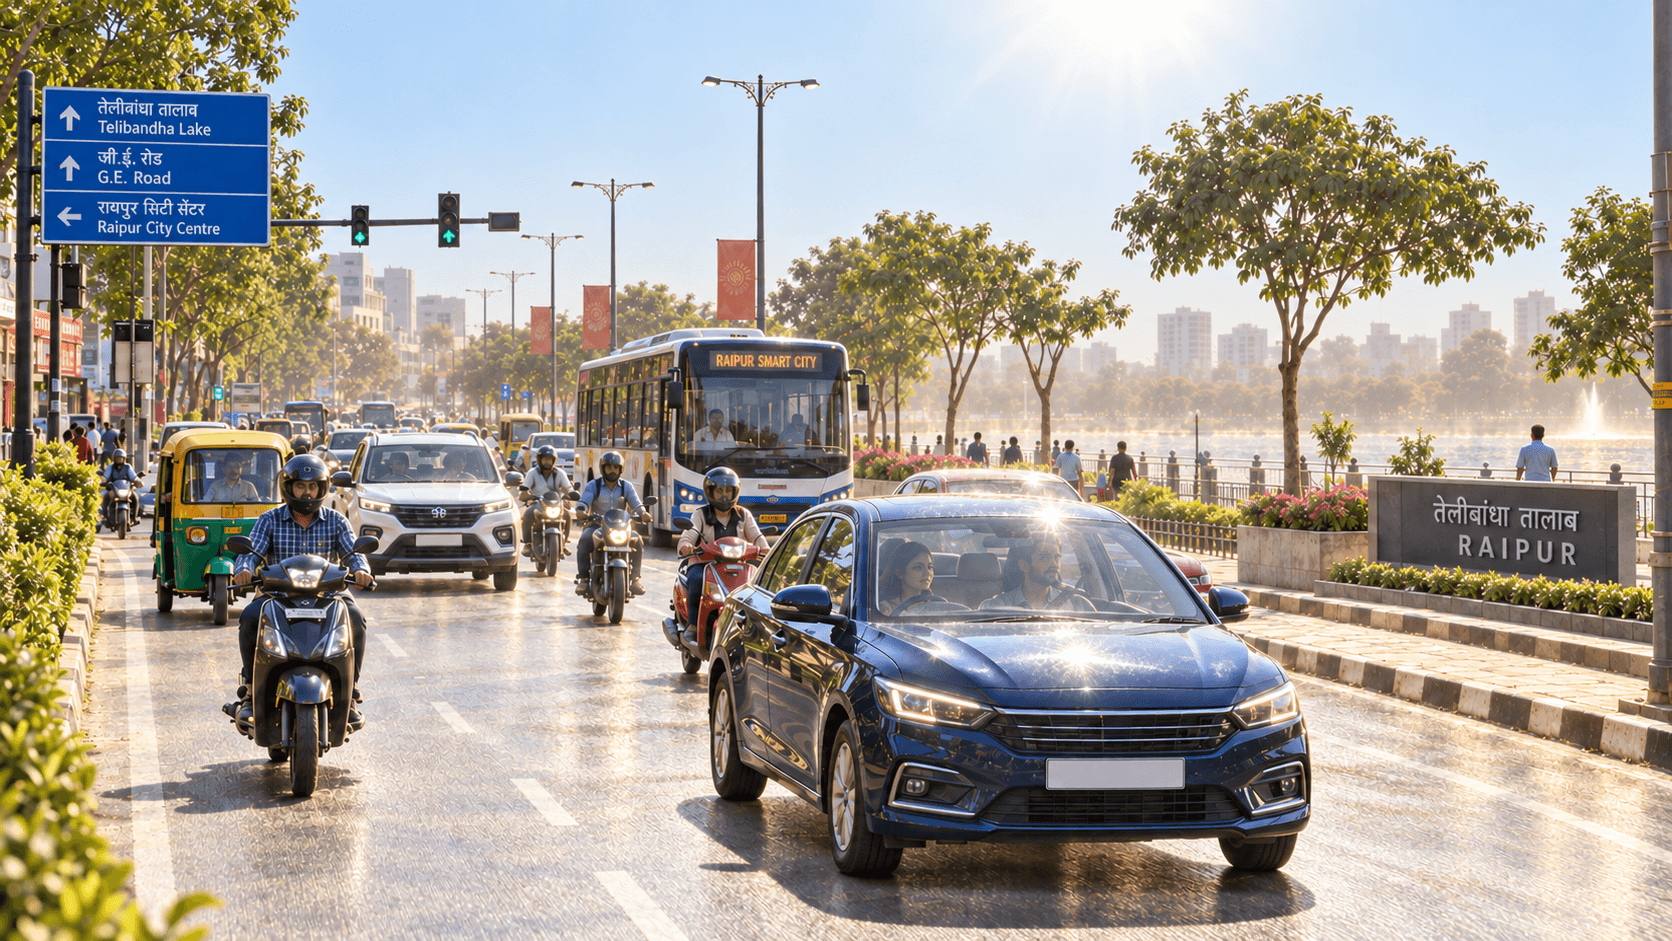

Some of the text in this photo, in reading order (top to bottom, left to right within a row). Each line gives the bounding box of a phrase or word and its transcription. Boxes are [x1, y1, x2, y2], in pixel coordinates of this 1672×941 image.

[97, 120, 211, 136] Telibandha Lake
[97, 147, 163, 168] जी.ई. रोड
[97, 170, 171, 185] G.E. Road
[97, 197, 206, 220] रायपुर सिटी सेंटर
[98, 220, 220, 238] Raipur City Centre
[716, 354, 817, 369] RAIPUR SMART CITY
[1433, 494, 1579, 532] तेलीबांधा तालाब
[1458, 534, 1577, 566] RAIPUR
